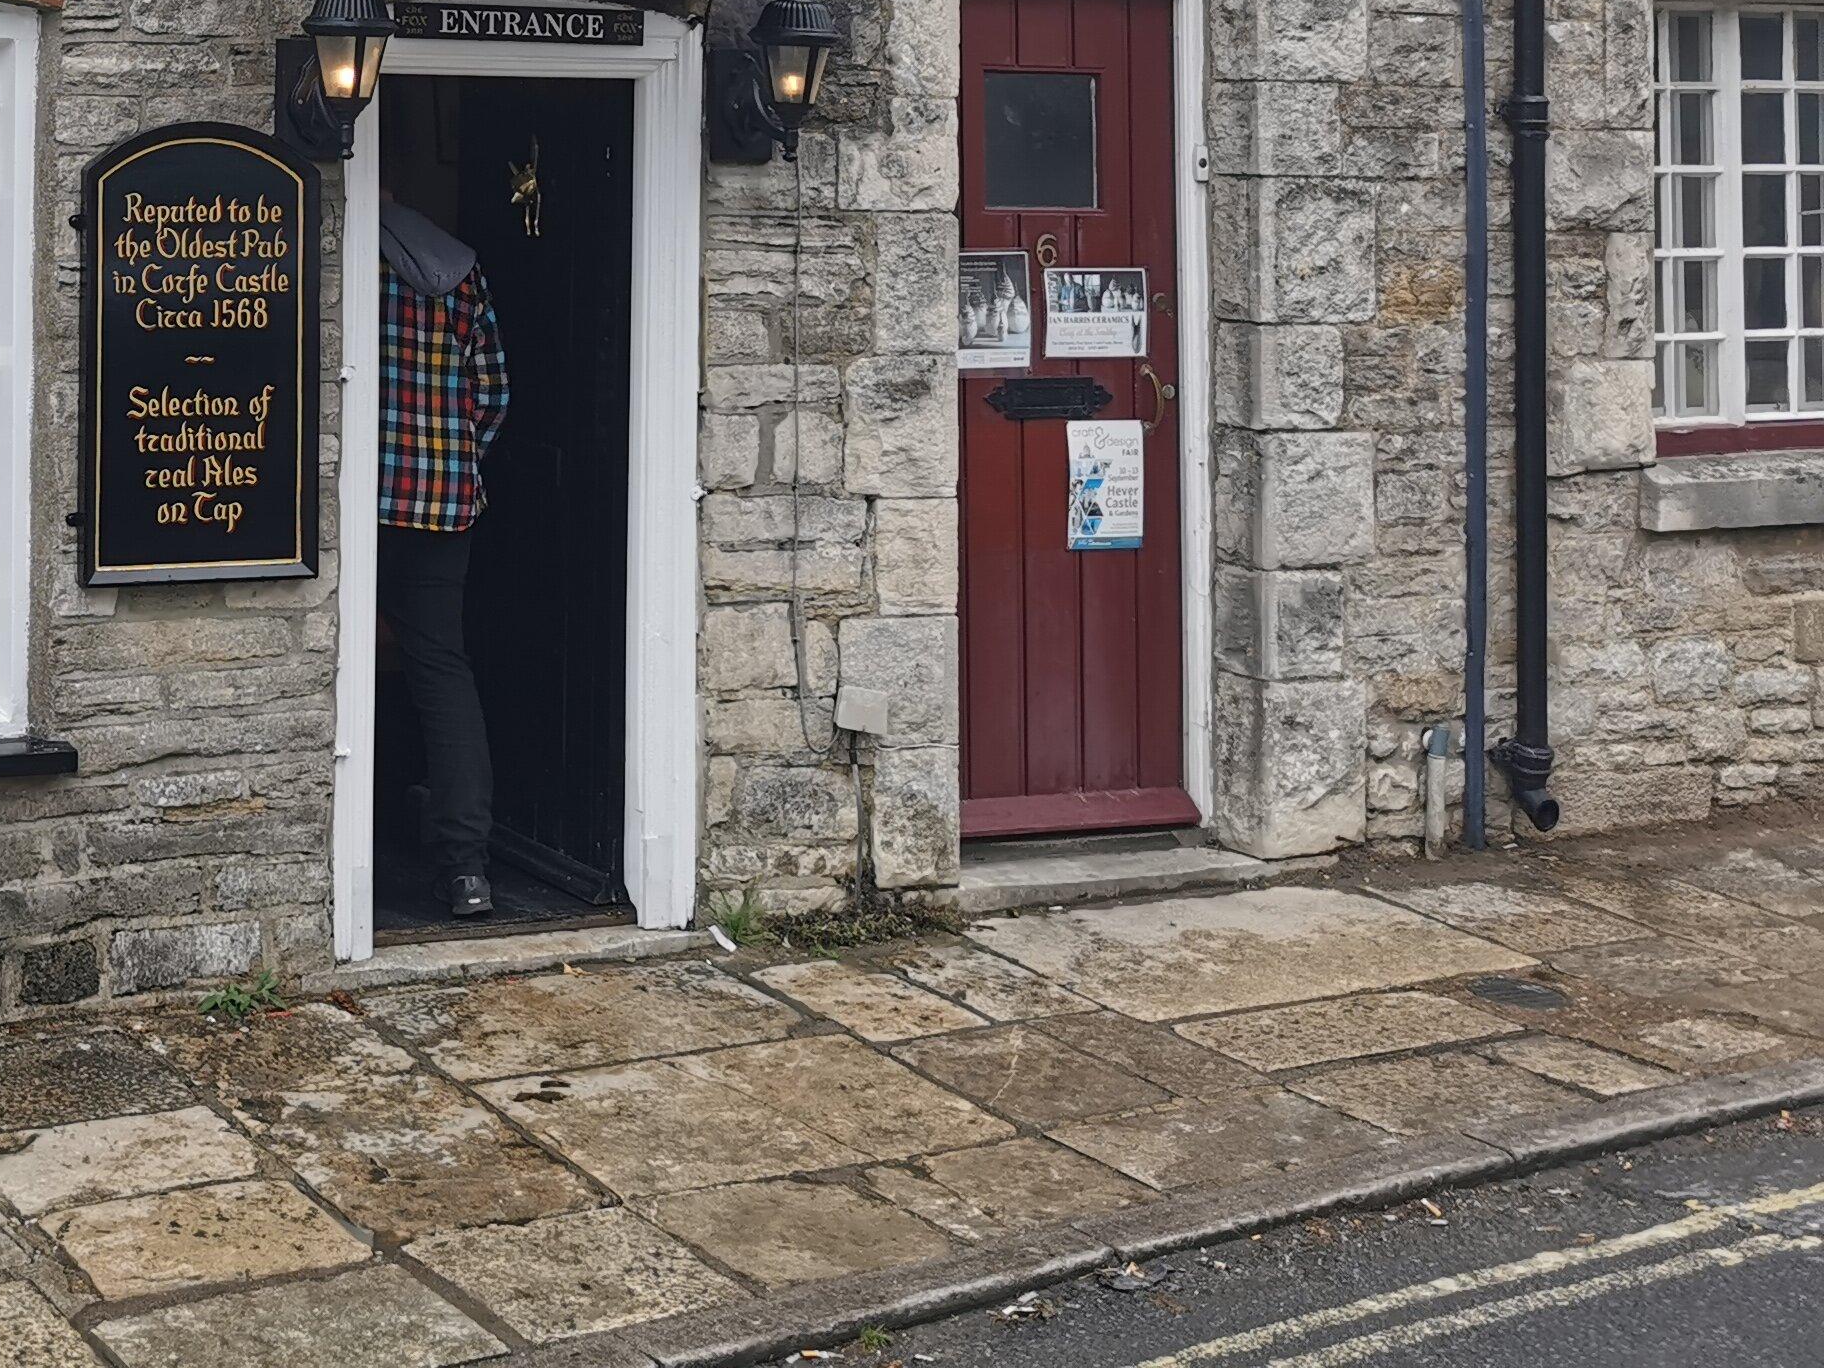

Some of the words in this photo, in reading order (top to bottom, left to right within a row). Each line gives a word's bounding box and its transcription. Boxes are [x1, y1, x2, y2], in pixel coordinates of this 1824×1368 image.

[402, 16, 427, 26] FOX
[439, 9, 604, 39] ENTRANCE
[614, 23, 637, 33] FOX
[121, 192, 222, 232] Reputed
[227, 197, 250, 224] to
[256, 194, 282, 224] be
[114, 230, 151, 265] the
[156, 226, 238, 259] Oldest
[240, 229, 287, 259] Pub
[1037, 233, 1057, 267] 6
[113, 269, 136, 295] in
[141, 266, 208, 304] Corfe
[215, 264, 289, 295] Castle
[135, 298, 203, 331] Circa
[210, 298, 268, 329] 1568
[1049, 316, 1061, 324] IAN
[126, 385, 240, 420] Selection
[249, 385, 275, 423] of
[134, 424, 266, 452] traditional
[1072, 427, 1094, 437] craft
[1094, 426, 1109, 449] &
[1107, 437, 1139, 448] design
[145, 456, 195, 488] real
[201, 456, 258, 487] Ales
[1108, 474, 1139, 482] September
[1105, 498, 1138, 508] Castle
[1107, 486, 1139, 495] Hever
[157, 498, 188, 524] on
[192, 492, 242, 532] Tap
